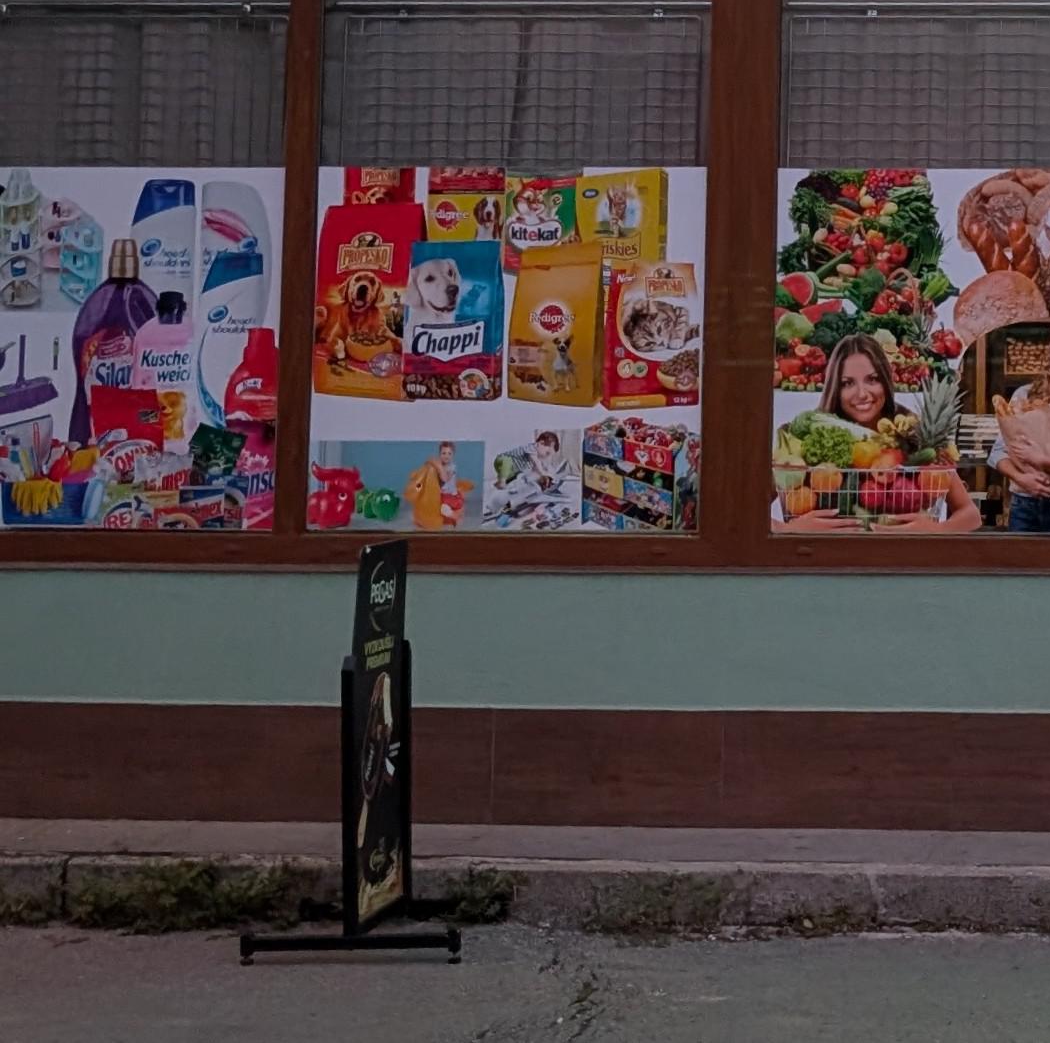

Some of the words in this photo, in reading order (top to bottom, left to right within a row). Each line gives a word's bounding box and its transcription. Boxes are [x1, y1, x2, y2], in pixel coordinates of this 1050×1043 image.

[511, 226, 560, 241] kitekat
[601, 241, 638, 256] riskies
[411, 326, 482, 355] Chappi
[141, 349, 192, 367] Kusche
